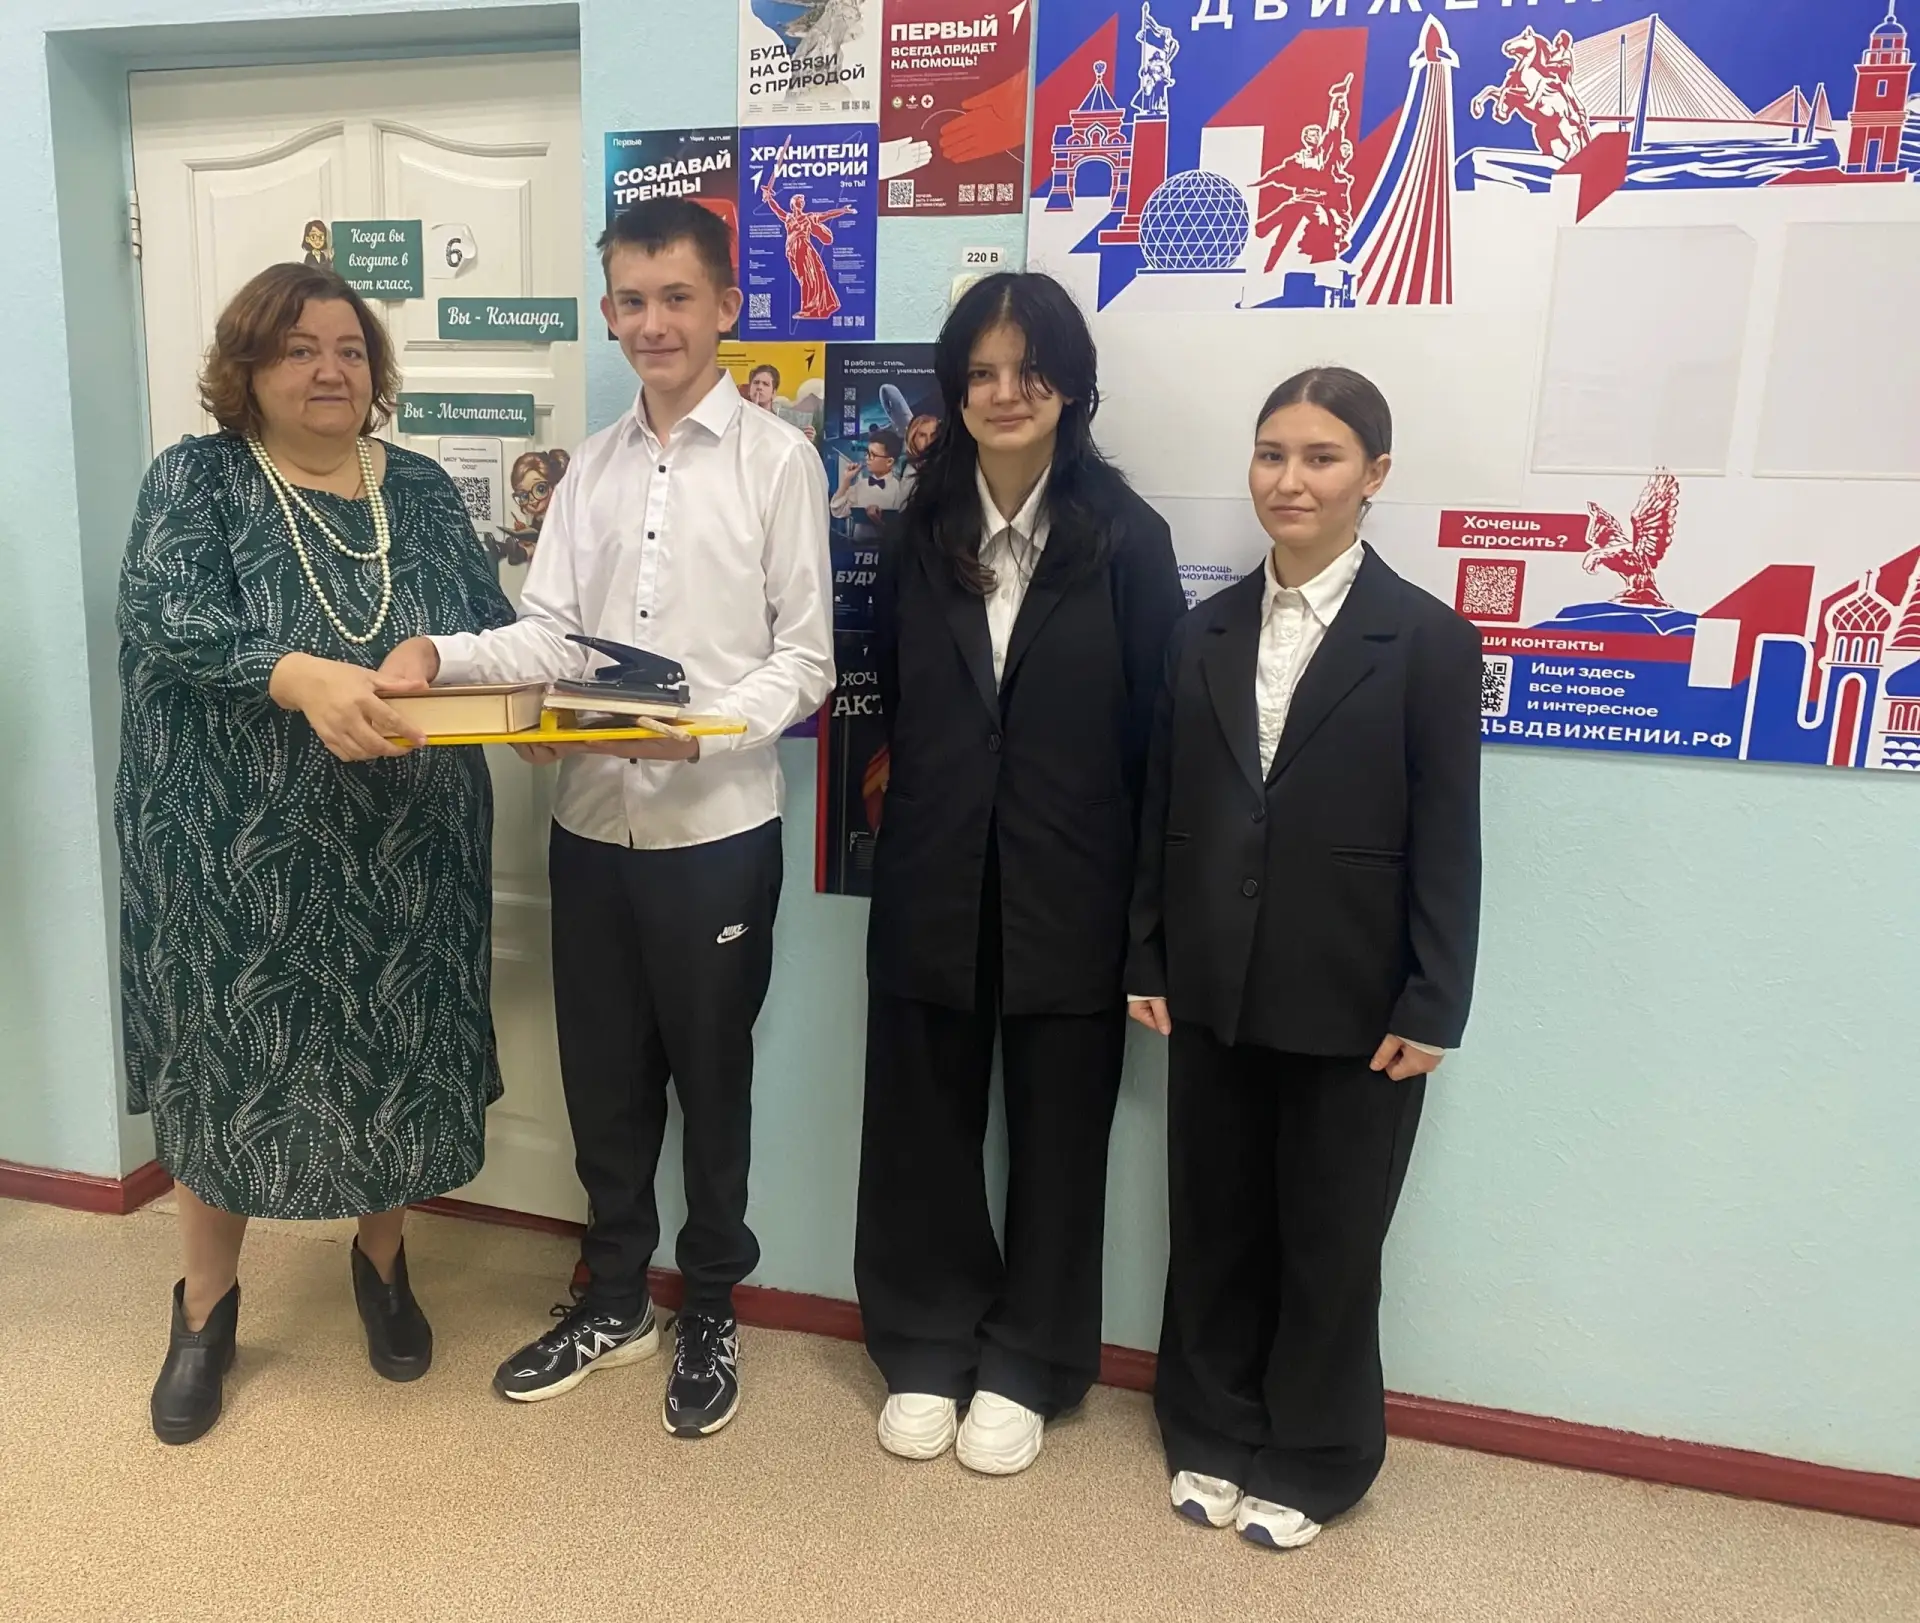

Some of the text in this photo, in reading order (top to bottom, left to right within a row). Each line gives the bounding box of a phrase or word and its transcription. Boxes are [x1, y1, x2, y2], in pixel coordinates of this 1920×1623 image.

[891, 14, 998, 41] ПЕРВЫЙ
[891, 42, 997, 57] ВСЕГДА ПРИДЕТ
[750, 54, 838, 78] НА СВЯЗИ
[891, 56, 978, 69] НА ПОМОЩЬ!
[749, 64, 865, 95] С ПРИРОДОЙ
[613, 138, 642, 148] Первые
[750, 143, 868, 161] ХРАНИТЕЛИ
[613, 149, 731, 186] СОЗДАВАЙ
[774, 161, 868, 178] ИСТОРИИ
[613, 177, 701, 205] ТРЕНДЫ
[350, 228, 406, 249] Когда вы
[446, 237, 463, 268] 6
[967, 252, 987, 263] 220
[348, 252, 409, 273] входите в
[345, 279, 413, 292] тот класс,
[447, 306, 472, 325] Вы
[486, 306, 564, 334] Команда,
[403, 402, 425, 418] Вы
[437, 402, 527, 423] Мечтатели,
[1463, 515, 1541, 531] Хочешь
[1461, 534, 1568, 548] спросить?
[1511, 637, 1604, 652] контакты
[1531, 662, 1636, 680] Ищи здесь
[1529, 682, 1625, 697] все новое
[1527, 701, 1659, 717] и интересное
[722, 923, 744, 937] NIKE
